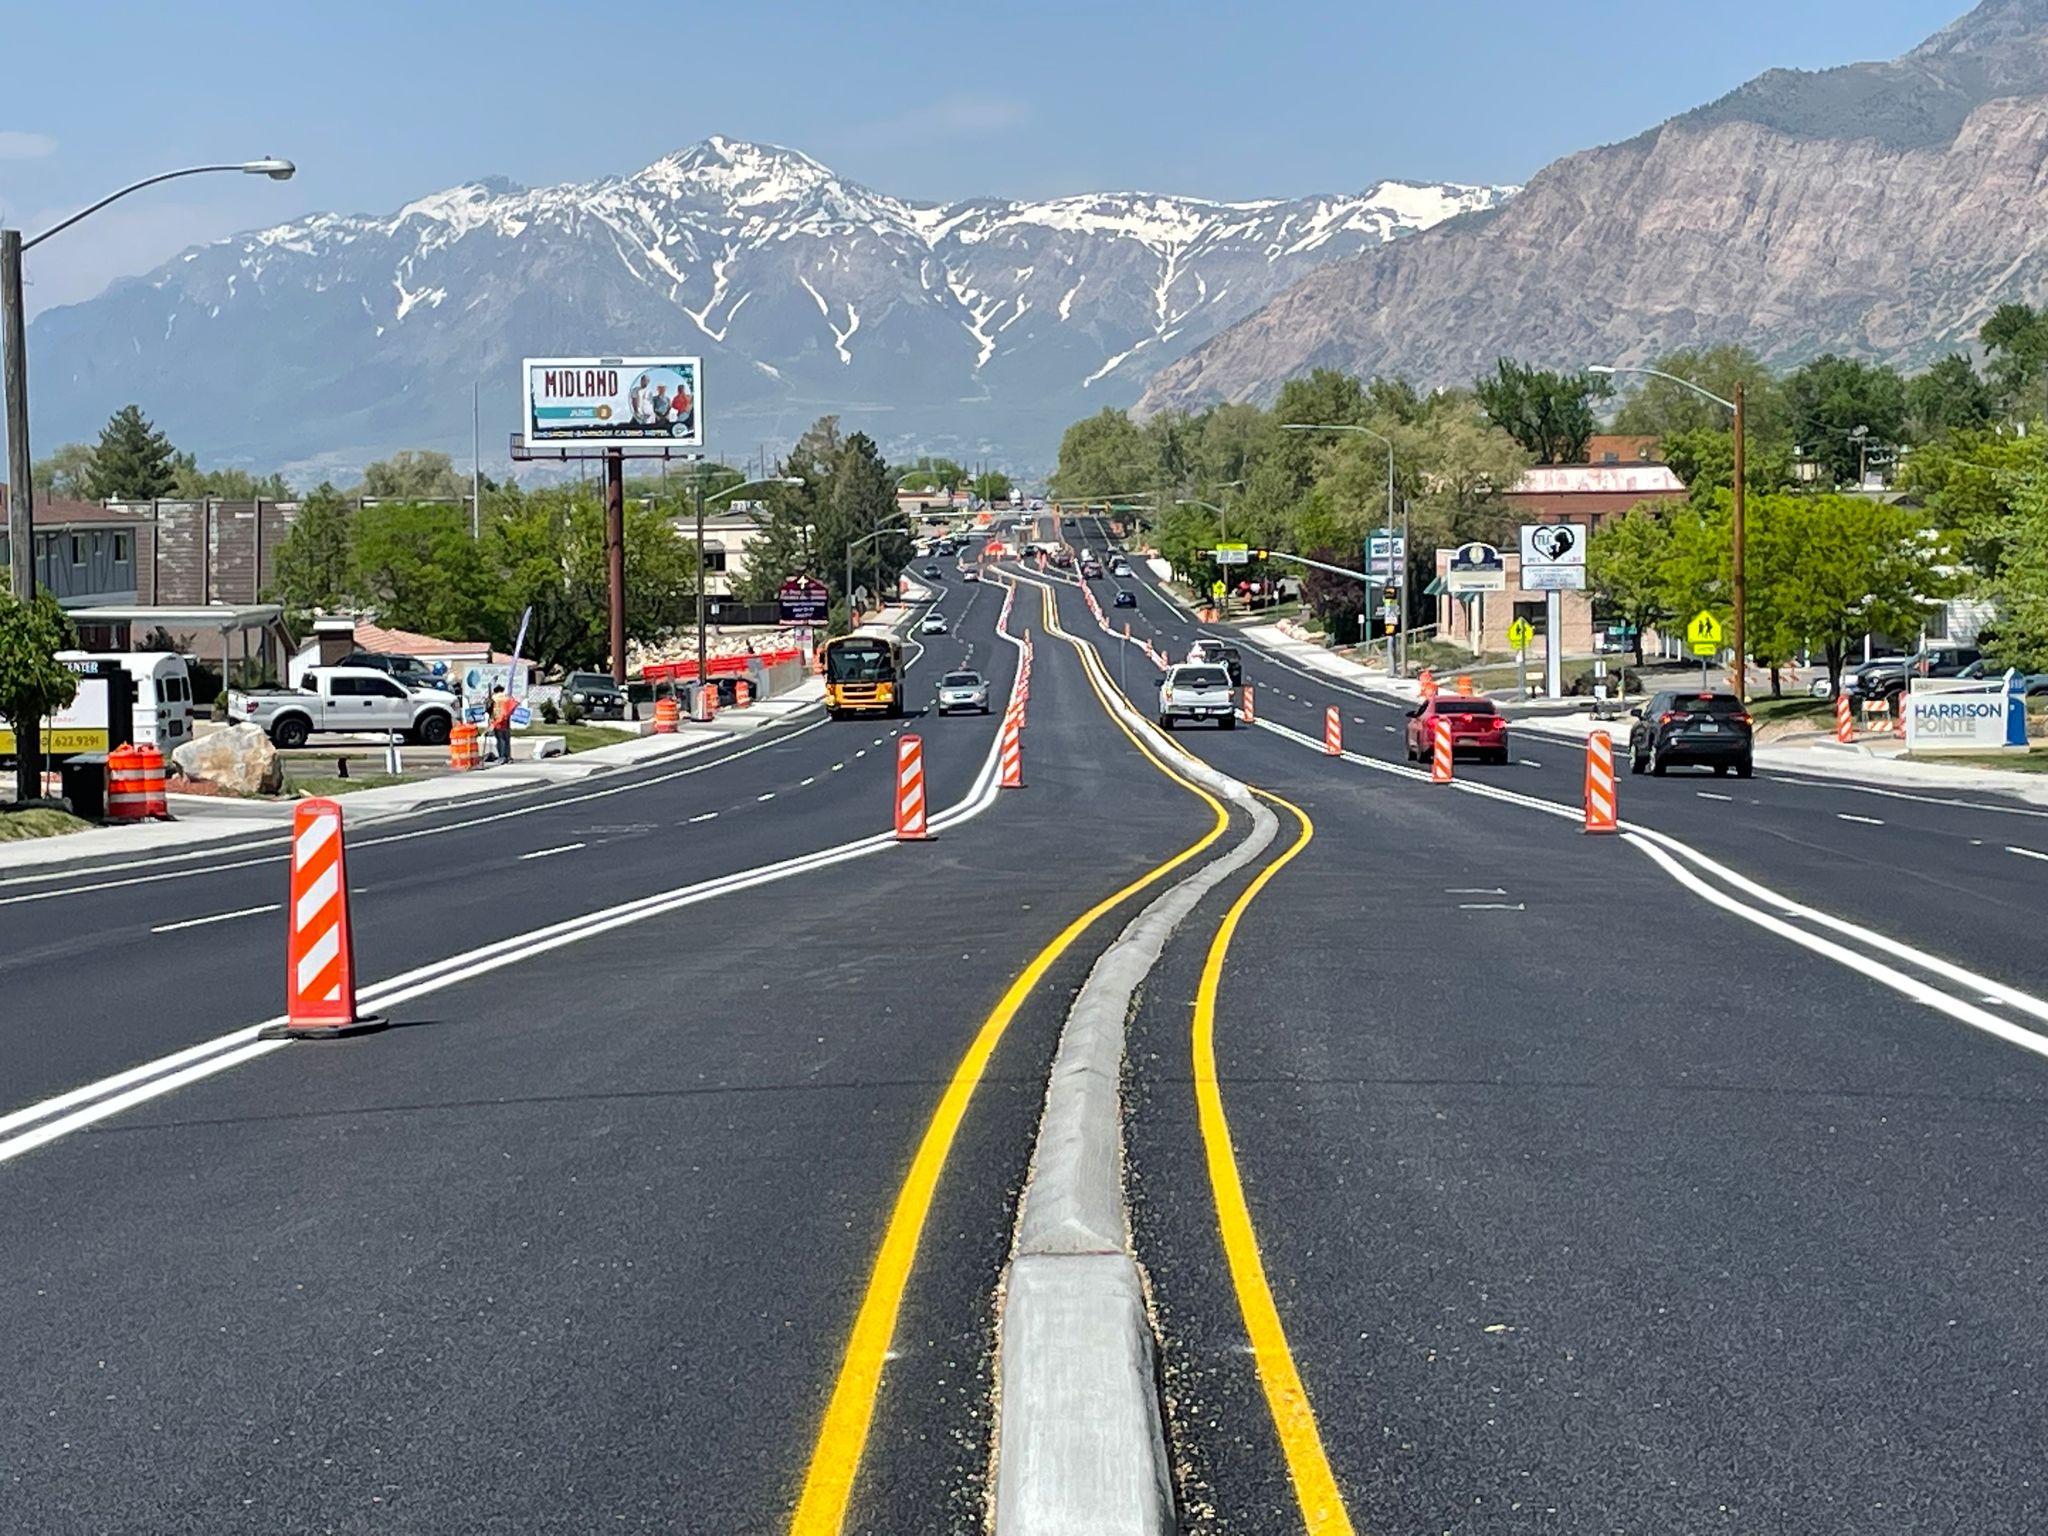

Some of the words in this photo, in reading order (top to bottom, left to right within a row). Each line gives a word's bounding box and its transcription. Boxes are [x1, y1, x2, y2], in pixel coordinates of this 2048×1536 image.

[545, 370, 619, 398] MIDLAND
[63, 662, 98, 673] ENTER
[1914, 703, 2002, 718] HARRISON
[1915, 719, 1976, 732] POINTE
